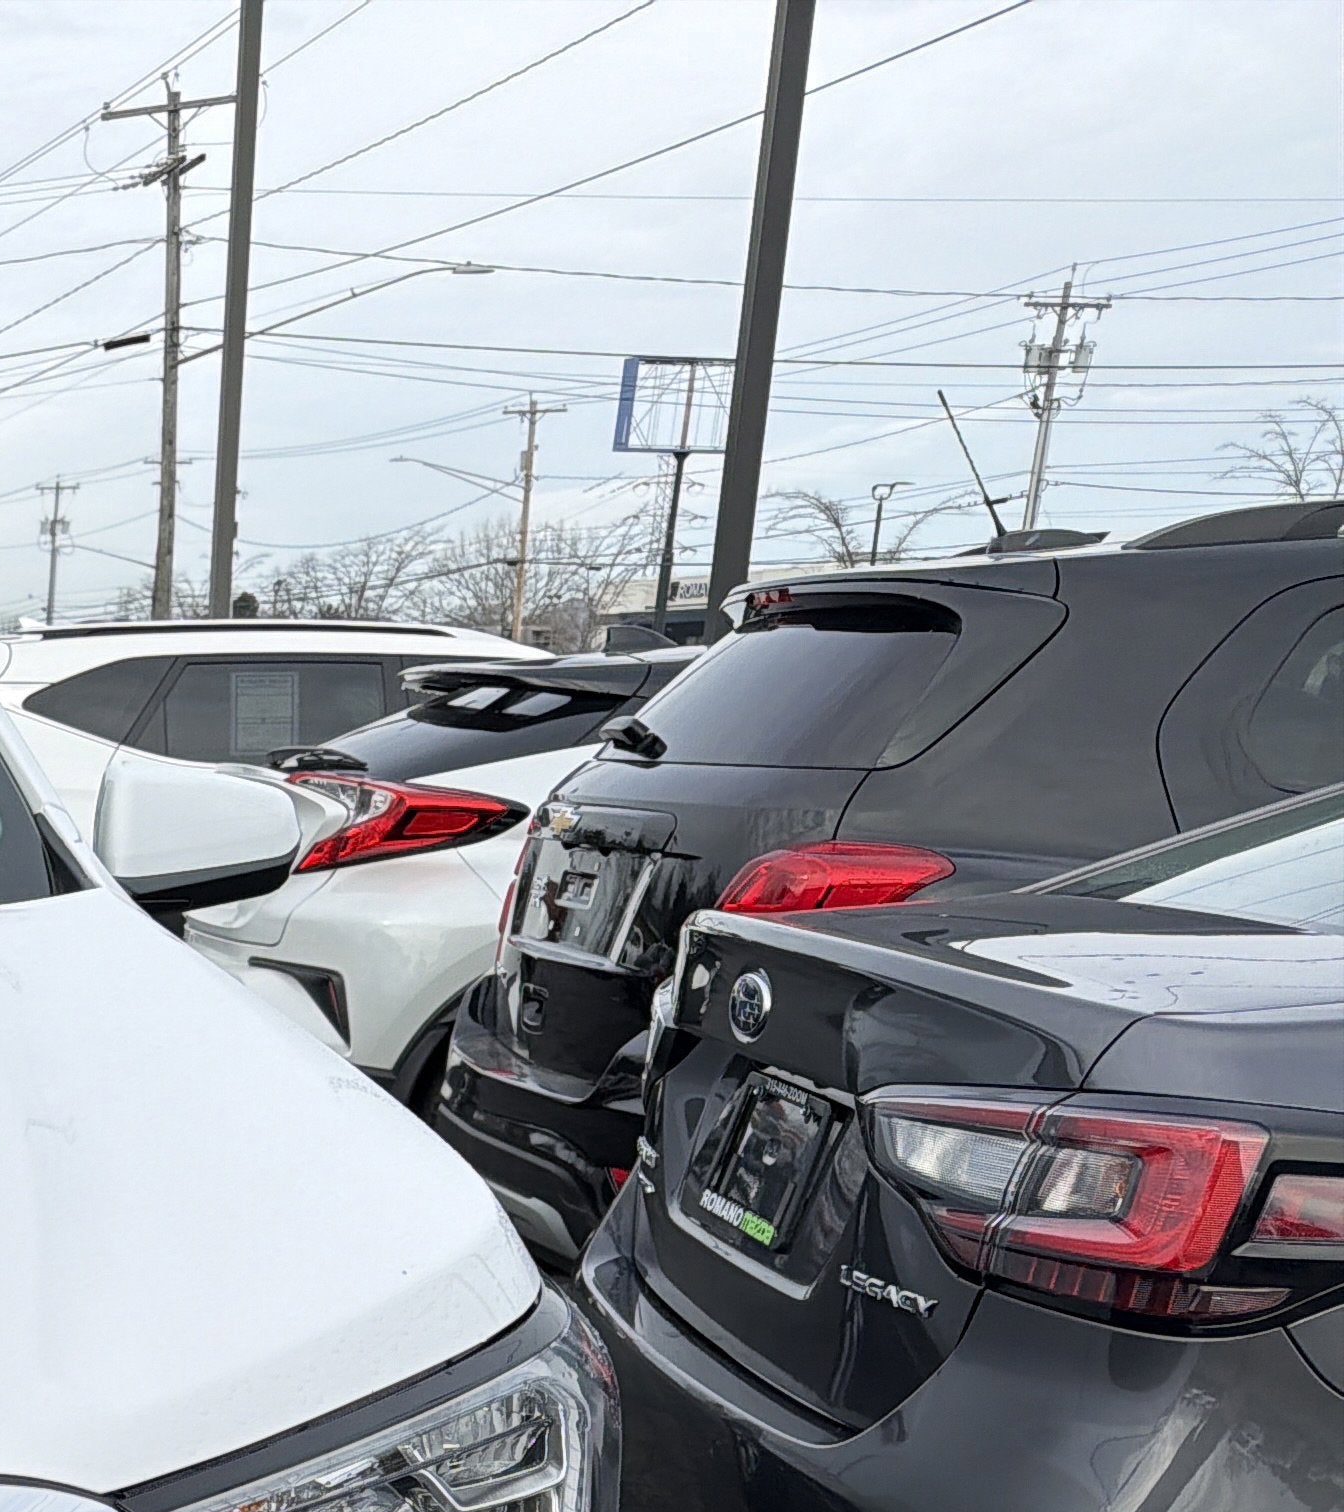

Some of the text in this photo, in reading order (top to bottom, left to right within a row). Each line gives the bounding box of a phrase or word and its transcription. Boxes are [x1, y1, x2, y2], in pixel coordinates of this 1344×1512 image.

[679, 582, 708, 599] ROMA
[699, 1188, 744, 1227] ROMANO
[839, 1264, 938, 1318] LEGACY
